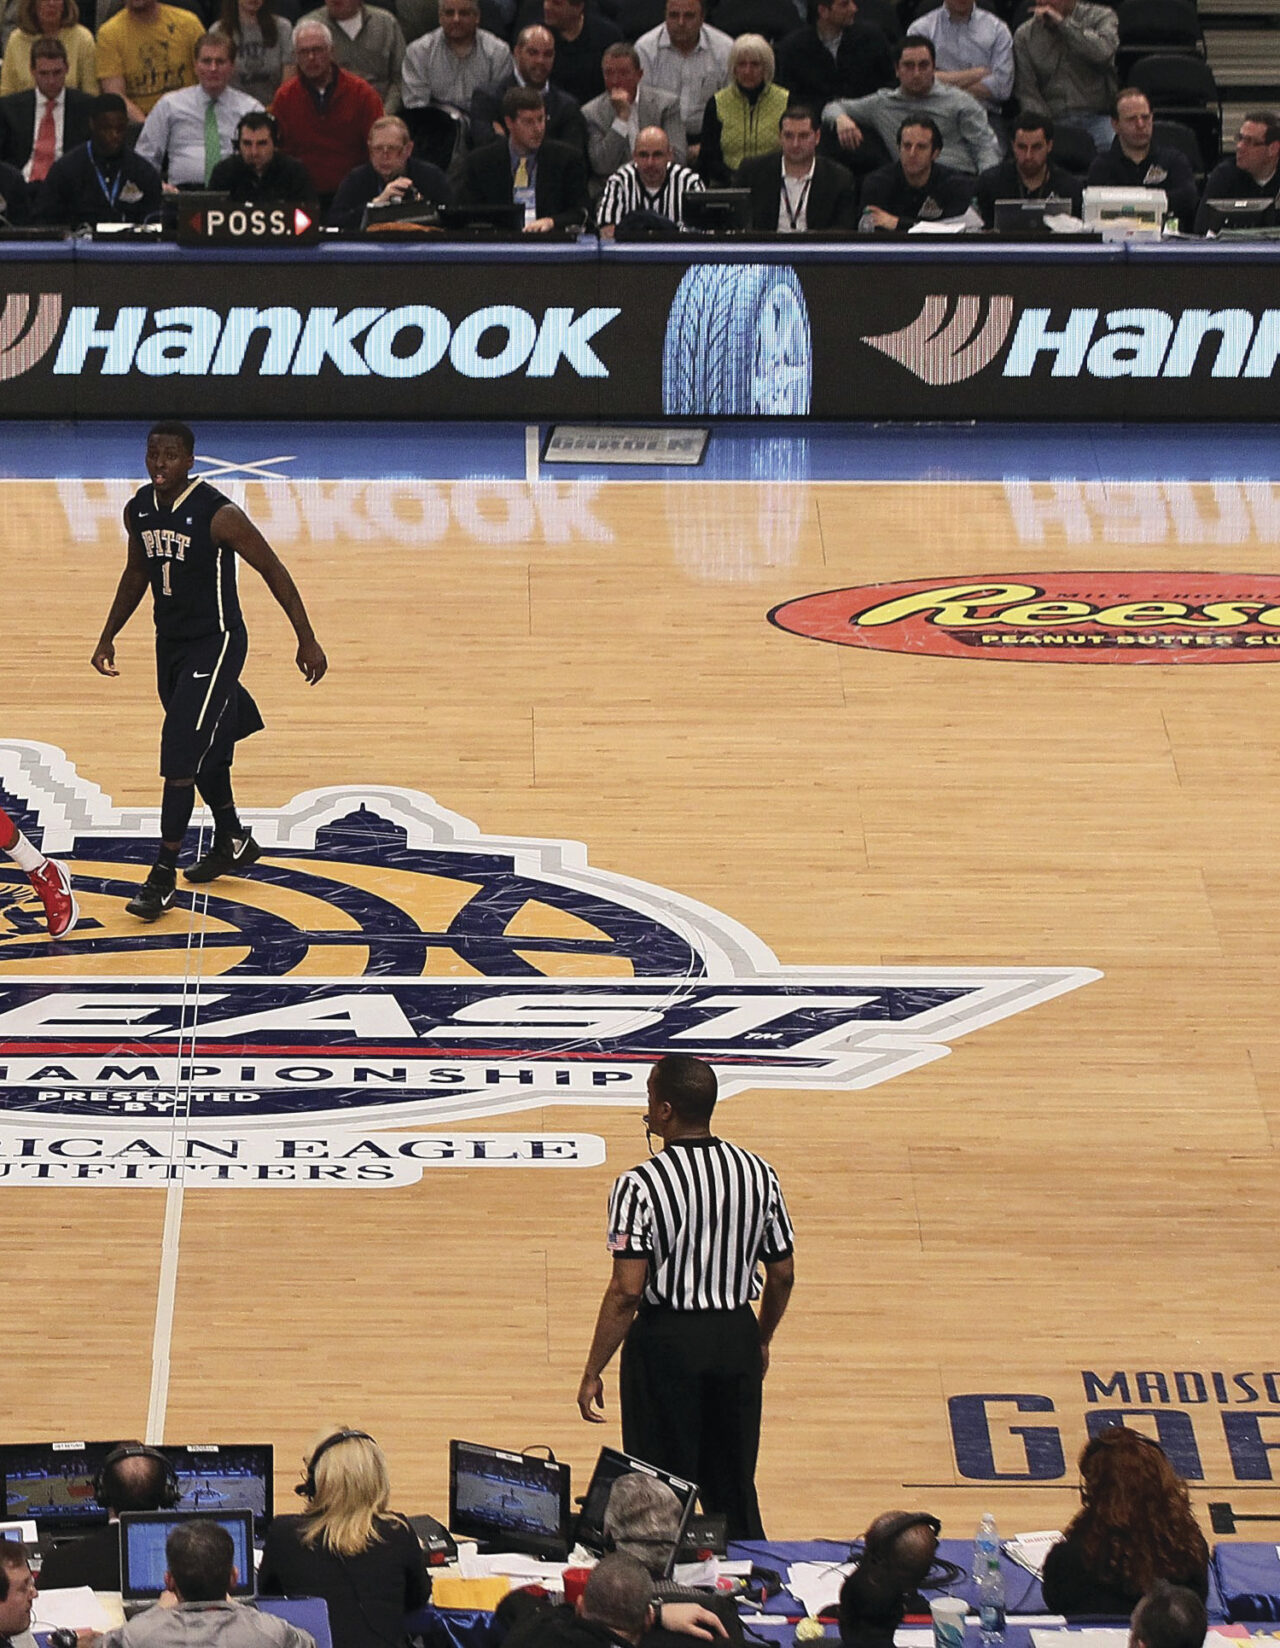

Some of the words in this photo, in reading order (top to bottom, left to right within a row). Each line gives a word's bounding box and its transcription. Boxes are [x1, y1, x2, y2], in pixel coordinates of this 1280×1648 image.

[207, 210, 291, 236] POSS.
[141, 529, 192, 561] PITT
[161, 561, 173, 596] 1
[981, 634, 1105, 645] PEANUT
[1116, 634, 1233, 645] BUTTER
[37, 1091, 261, 1102] PRESENTED
[274, 1139, 579, 1160] EAGLE
